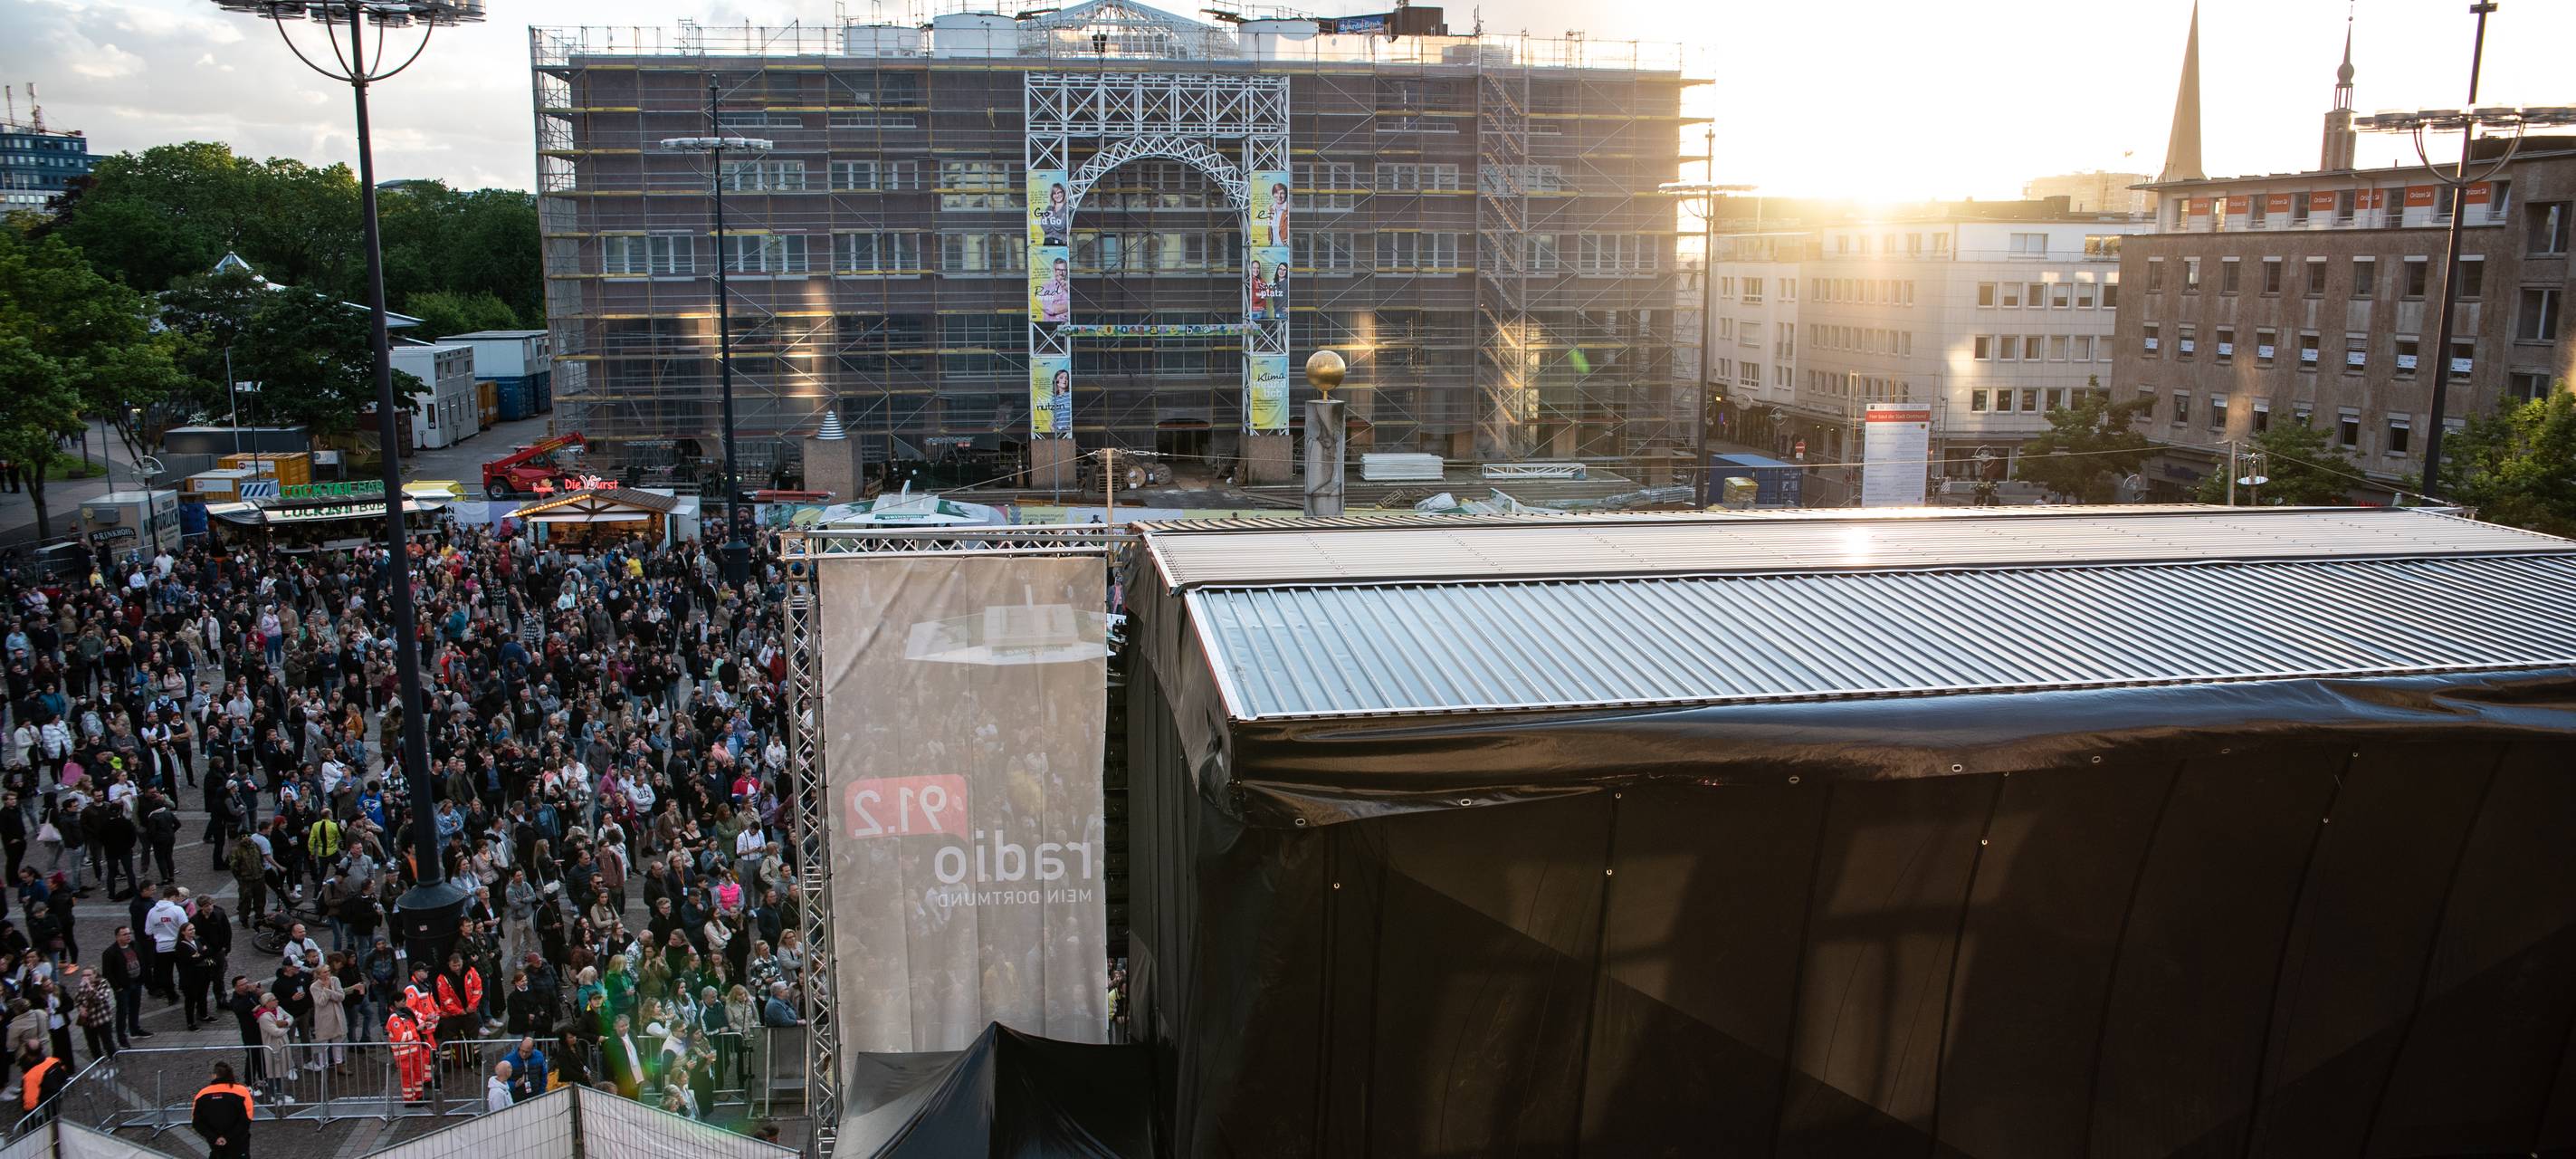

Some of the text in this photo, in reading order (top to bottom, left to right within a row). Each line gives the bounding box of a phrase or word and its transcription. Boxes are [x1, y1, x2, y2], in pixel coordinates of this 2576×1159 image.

[280, 480, 385, 499] COCKTAIL BAR
[565, 474, 619, 490] Die Wurst
